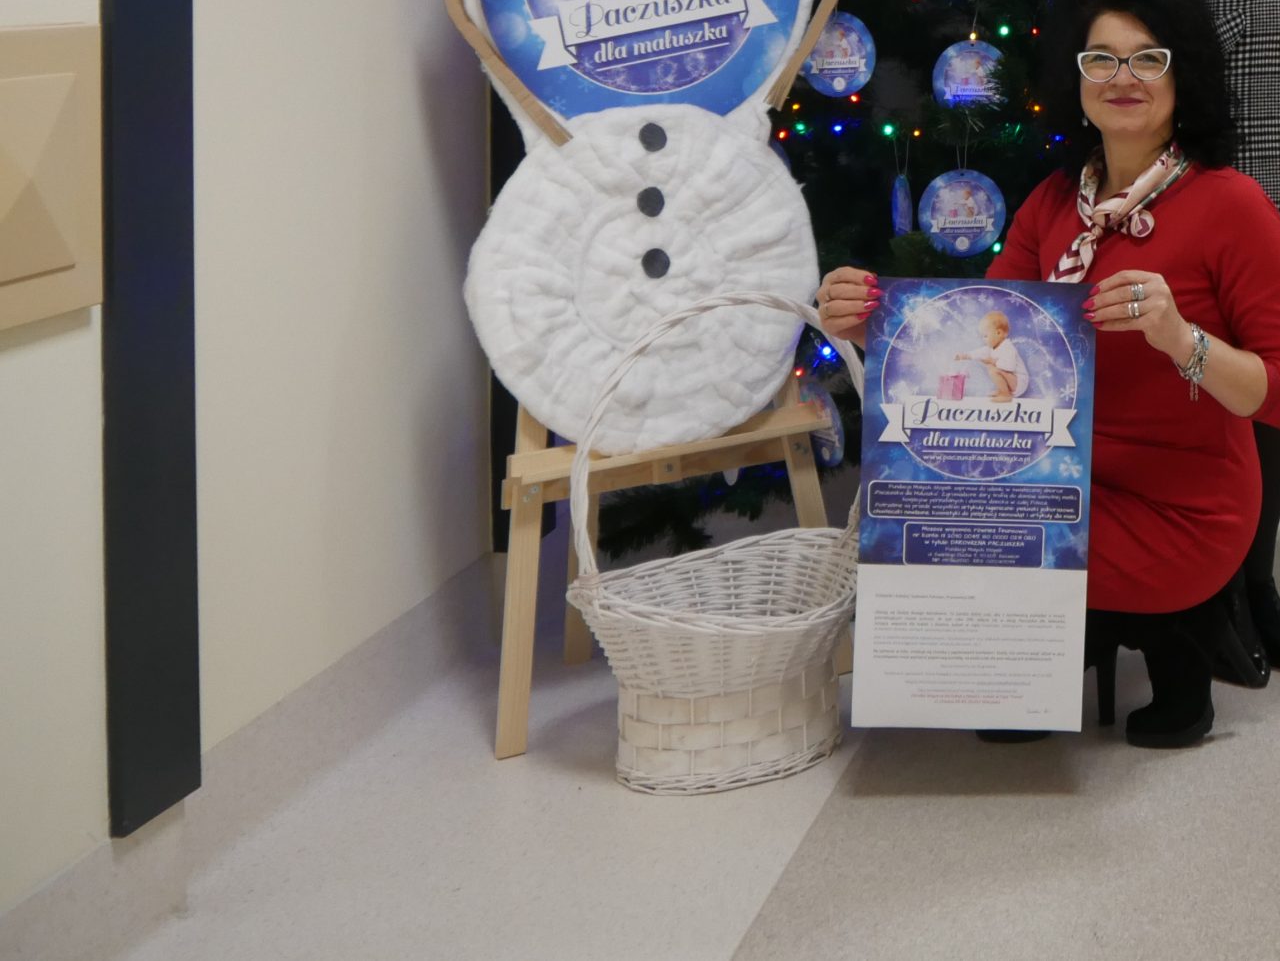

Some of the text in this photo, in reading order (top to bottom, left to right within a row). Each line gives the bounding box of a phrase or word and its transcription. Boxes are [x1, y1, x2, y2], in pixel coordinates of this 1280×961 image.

[594, 22, 728, 64] dla maluszka
[911, 398, 1042, 427] Paczuszka
[922, 431, 1033, 449] dla maluszka
